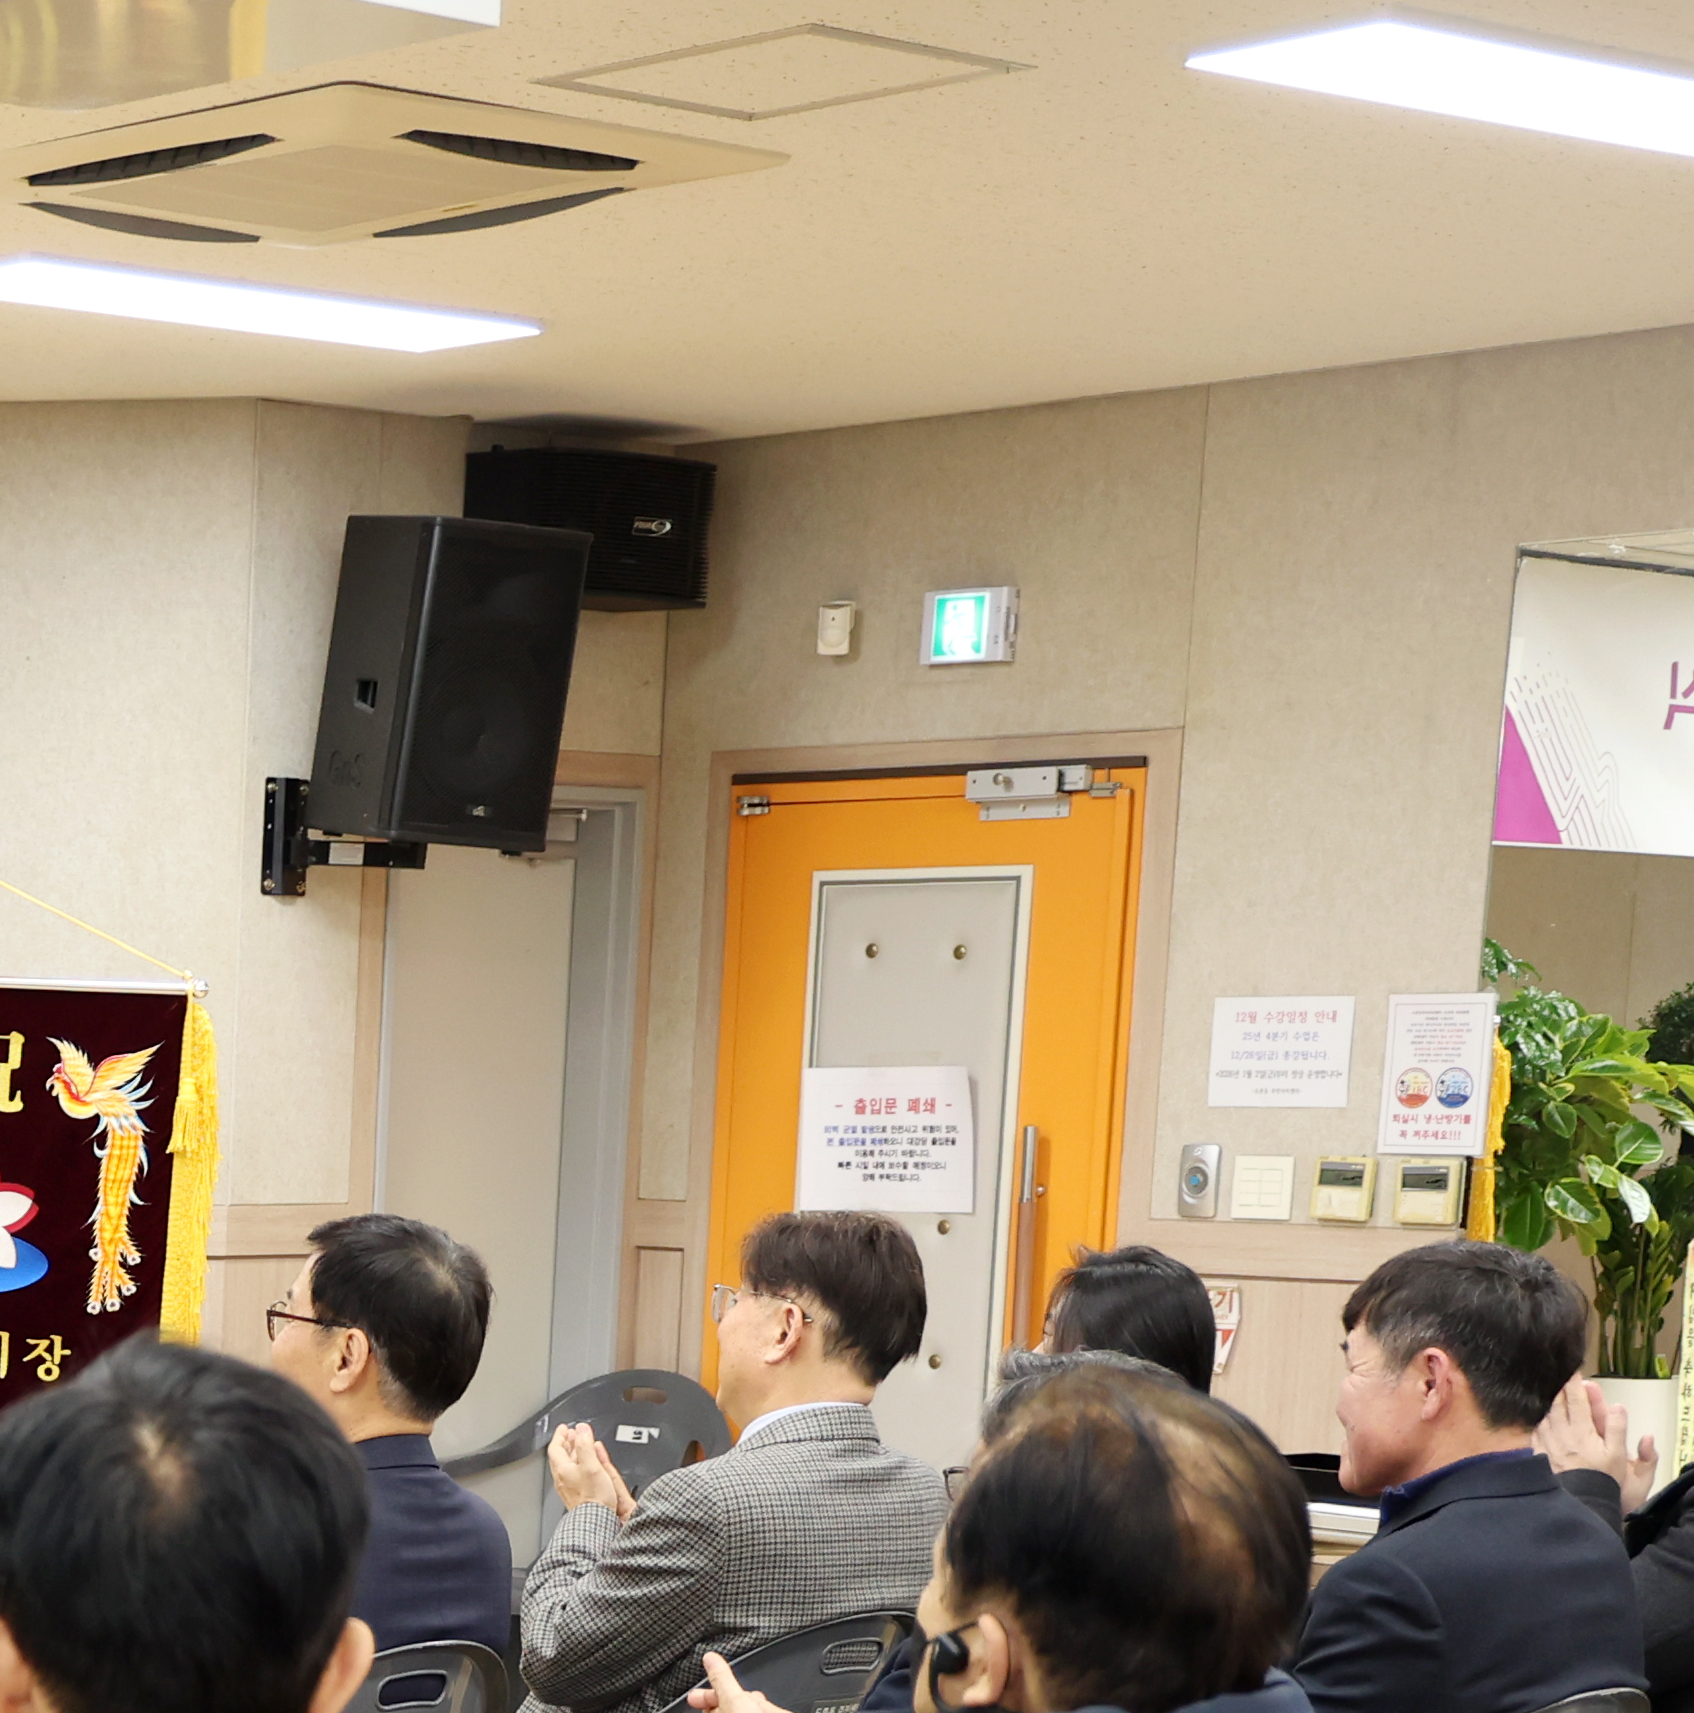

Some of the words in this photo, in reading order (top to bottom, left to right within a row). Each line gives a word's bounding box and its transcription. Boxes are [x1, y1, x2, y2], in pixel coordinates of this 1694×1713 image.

[1314, 1010, 1338, 1024] 안내
[854, 1097, 897, 1115] 출입문
[907, 1097, 937, 1115] 폐쇄
